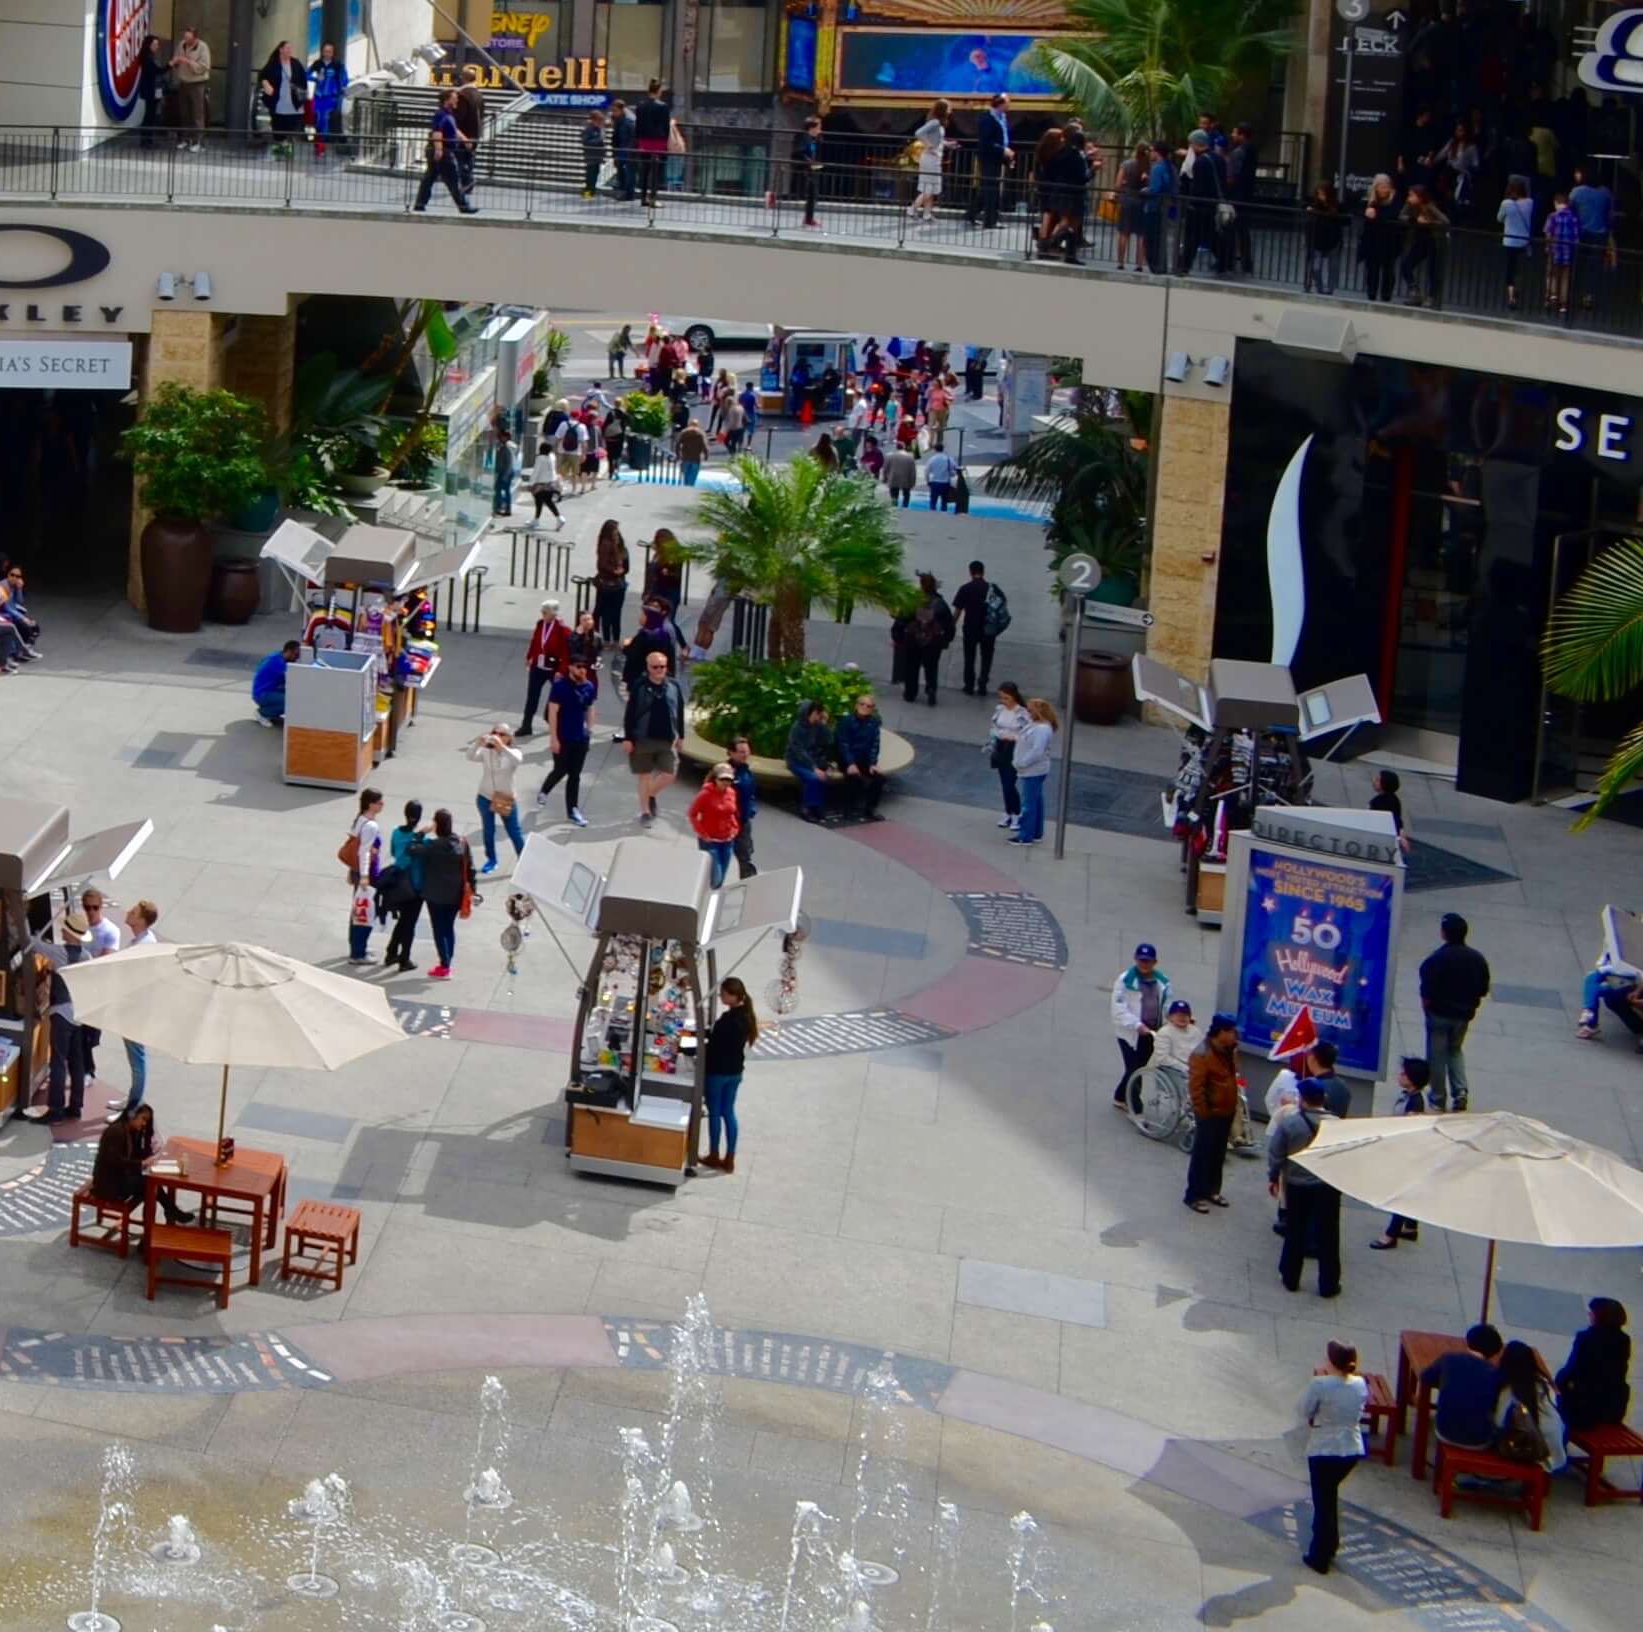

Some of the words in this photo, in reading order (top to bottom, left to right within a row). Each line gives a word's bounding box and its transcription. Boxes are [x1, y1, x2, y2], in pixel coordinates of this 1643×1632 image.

[39, 355, 112, 374] SECRET
[1069, 561, 1092, 588] 2
[1250, 819, 1398, 865] DIRECTORY
[1274, 879, 1325, 903] SINCE
[1328, 892, 1366, 912] 1965
[1290, 916, 1342, 950] 50
[1283, 978, 1335, 1006] WAX
[1266, 993, 1352, 1030] MUEUM
